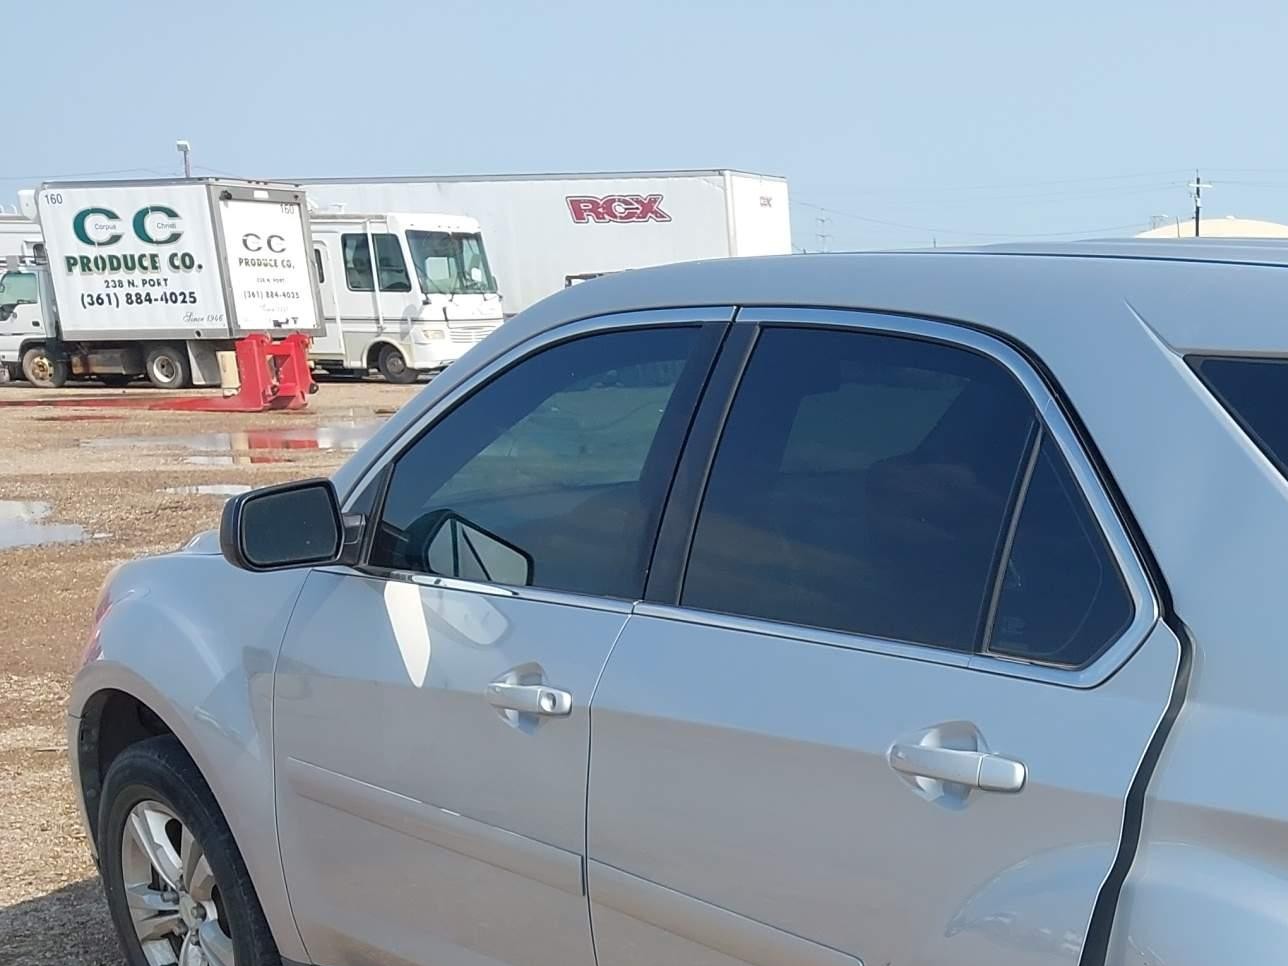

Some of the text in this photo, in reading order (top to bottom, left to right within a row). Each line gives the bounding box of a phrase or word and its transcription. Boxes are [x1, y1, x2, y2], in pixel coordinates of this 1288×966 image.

[44, 193, 63, 205] 160
[565, 194, 672, 223] RCX
[65, 252, 204, 274] PRODUCE CO.
[238, 257, 279, 269] PRODUCE
[104, 278, 169, 289] 238 N. PORT
[81, 291, 198, 309] (361) 884-4025
[183, 312, 224, 322] Since 1946
